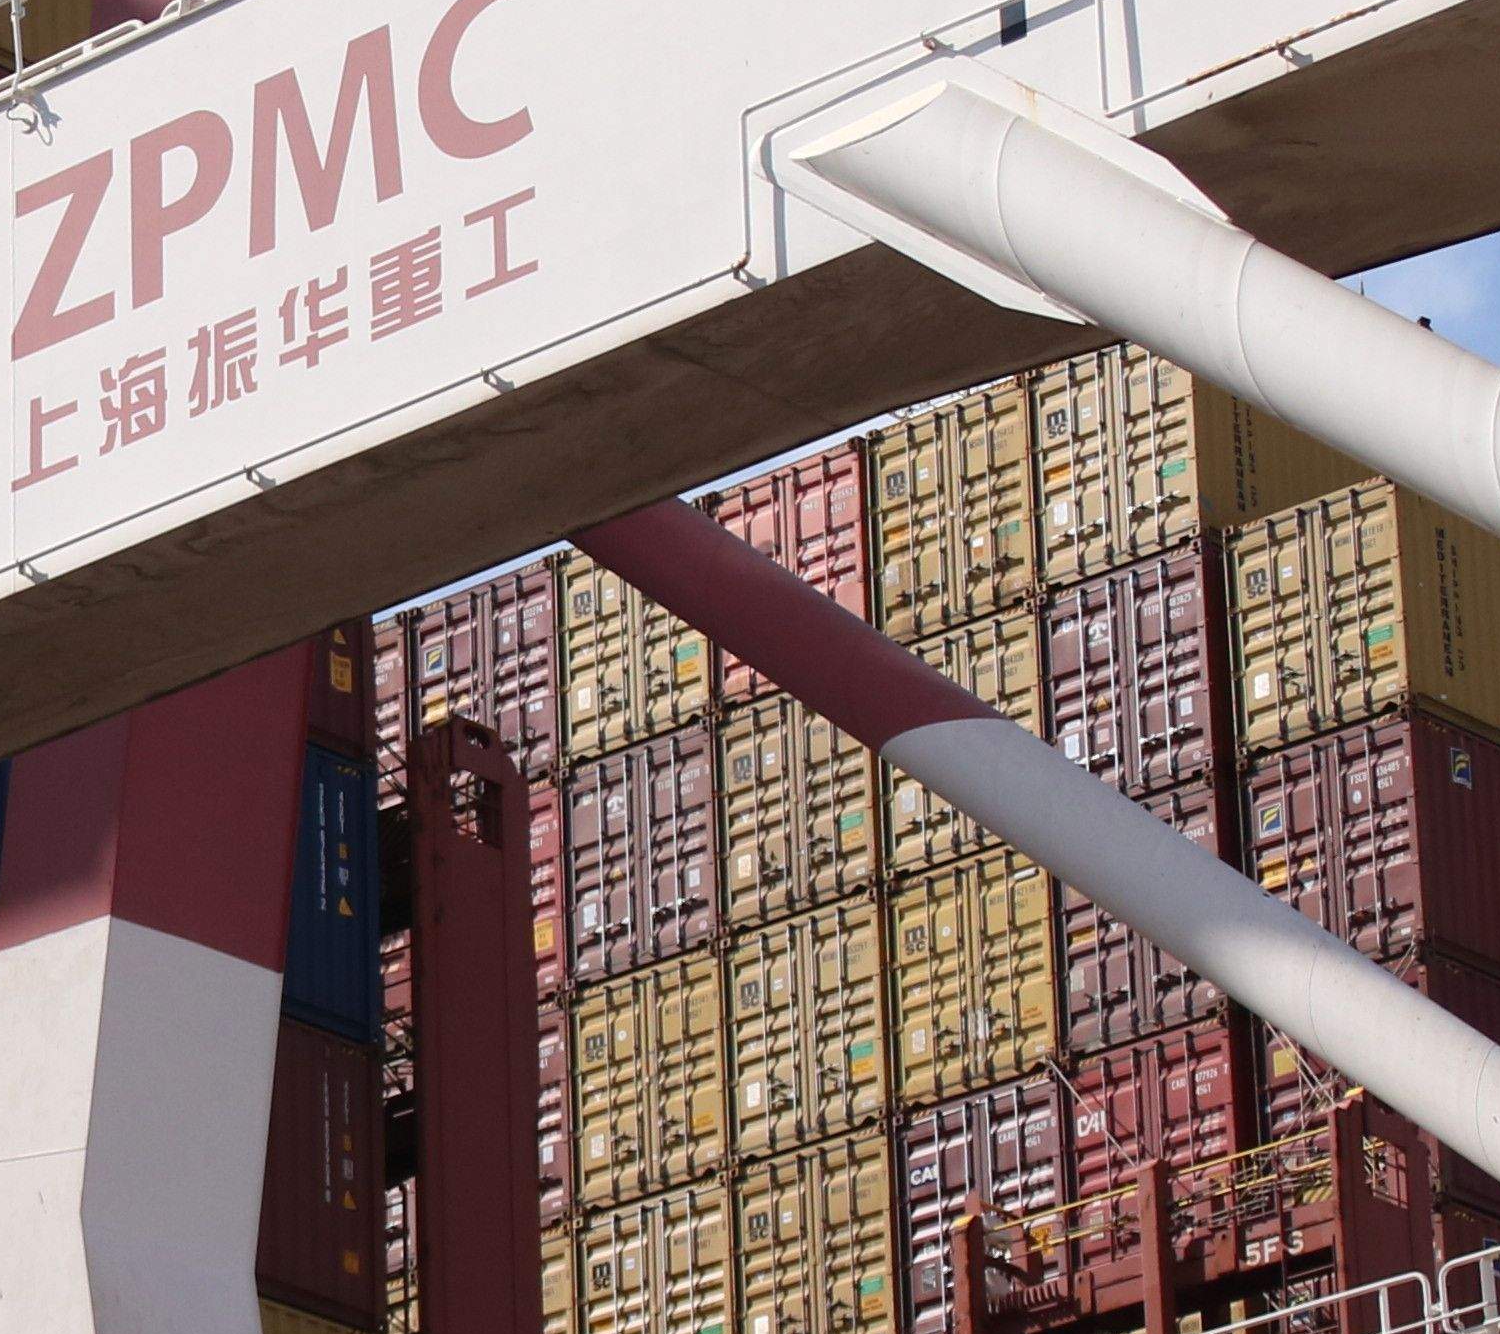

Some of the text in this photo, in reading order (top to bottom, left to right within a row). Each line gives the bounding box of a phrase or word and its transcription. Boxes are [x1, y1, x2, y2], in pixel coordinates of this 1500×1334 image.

[11, 186, 539, 492] 上海振华重工
[1435, 527, 1454, 678] MEDITERRANEAN
[1077, 1110, 1106, 1137] CAI
